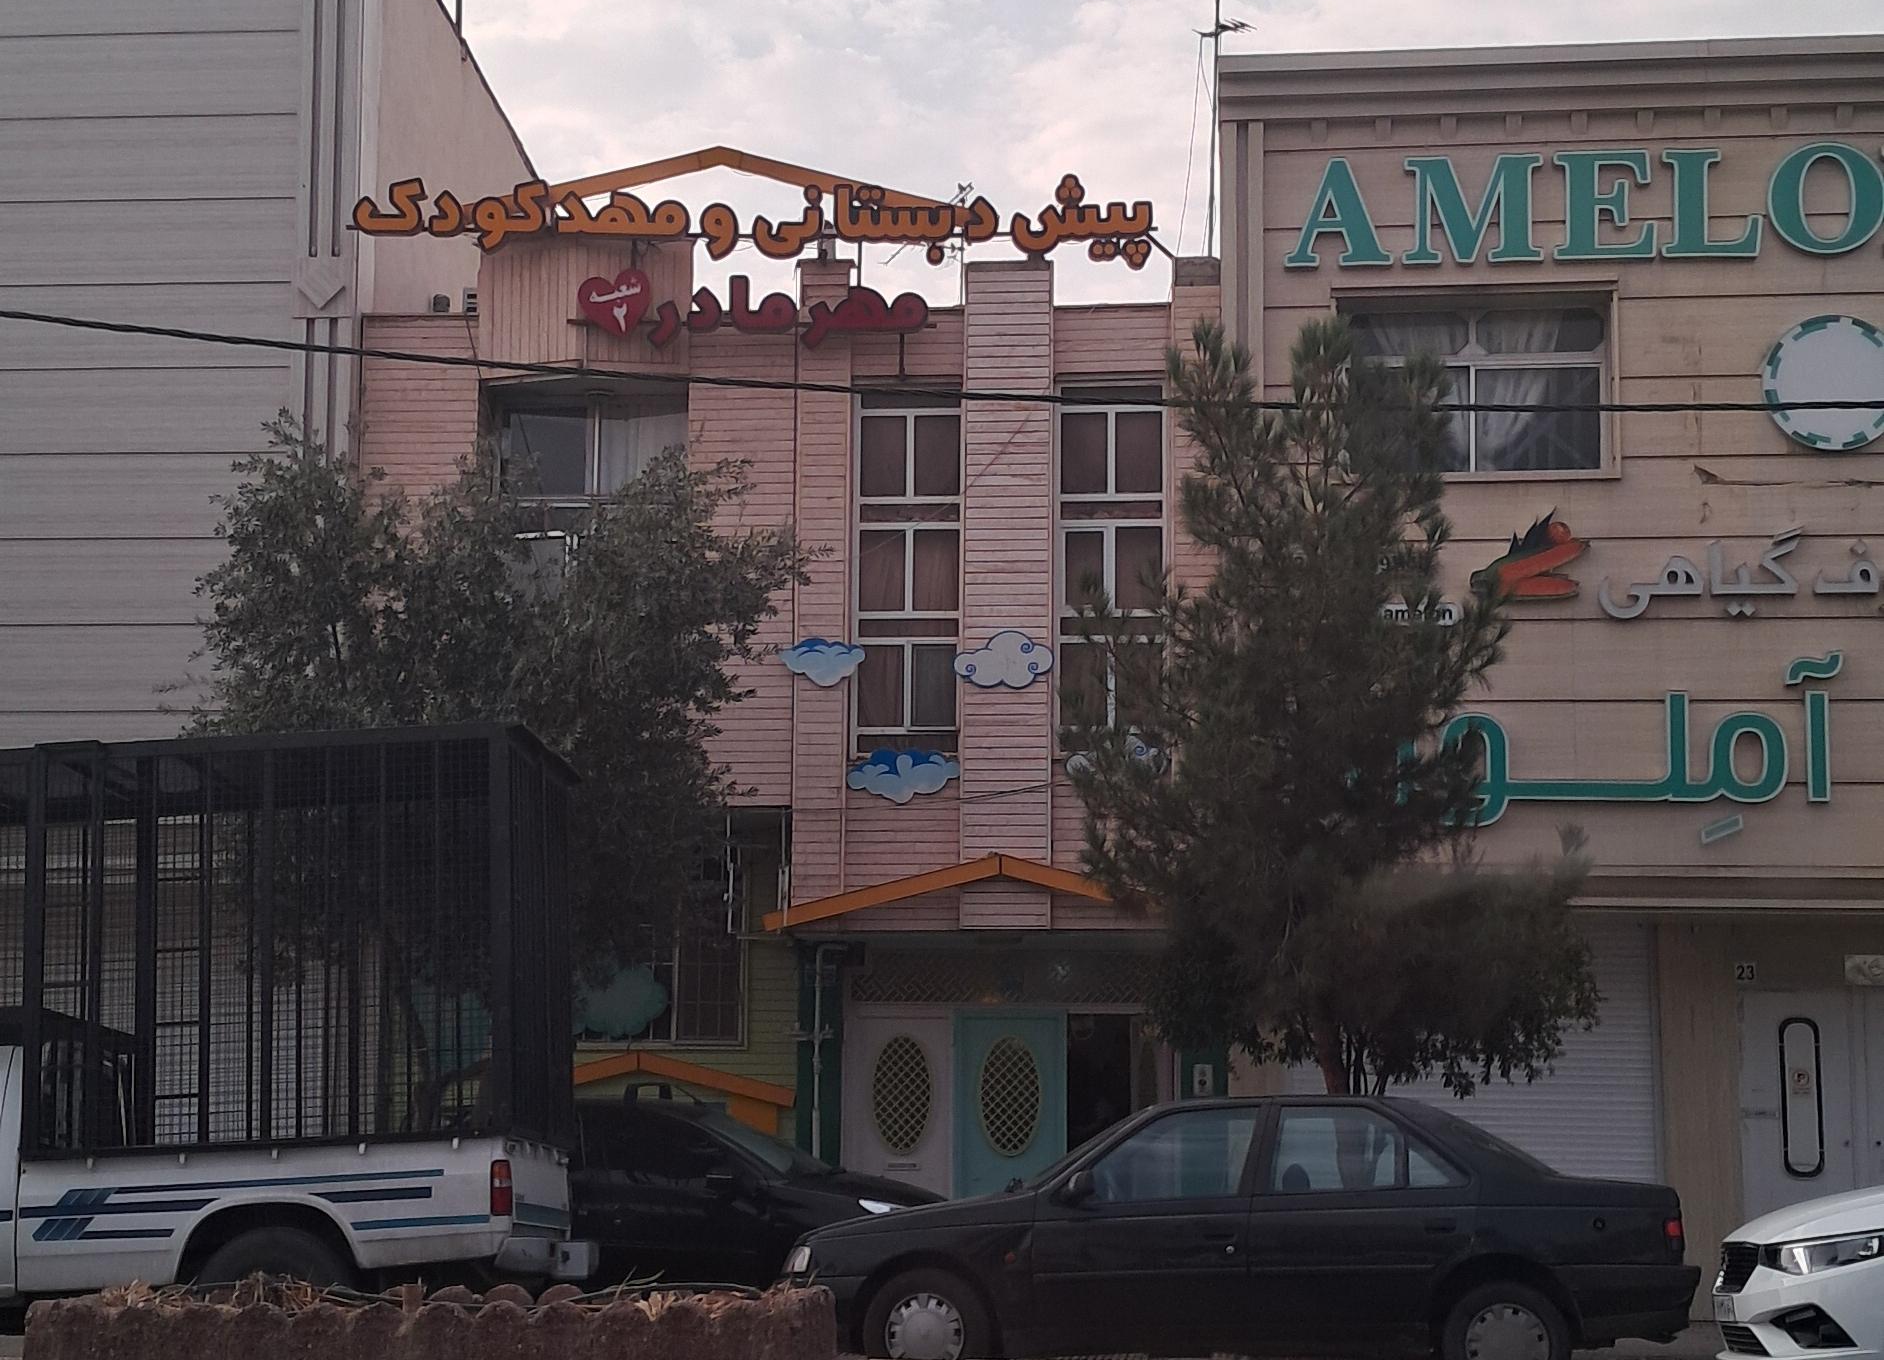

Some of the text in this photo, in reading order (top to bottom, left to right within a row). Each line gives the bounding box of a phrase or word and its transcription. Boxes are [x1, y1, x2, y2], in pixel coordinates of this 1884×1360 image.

[699, 201, 739, 259] و
[752, 183, 999, 265] دبستانی
[1010, 173, 1154, 271] پیش
[1285, 141, 1884, 269] AMELO
[646, 274, 929, 348] مهر مادر
[1599, 526, 1804, 620] گیاهی
[1736, 964, 1755, 981] 23
